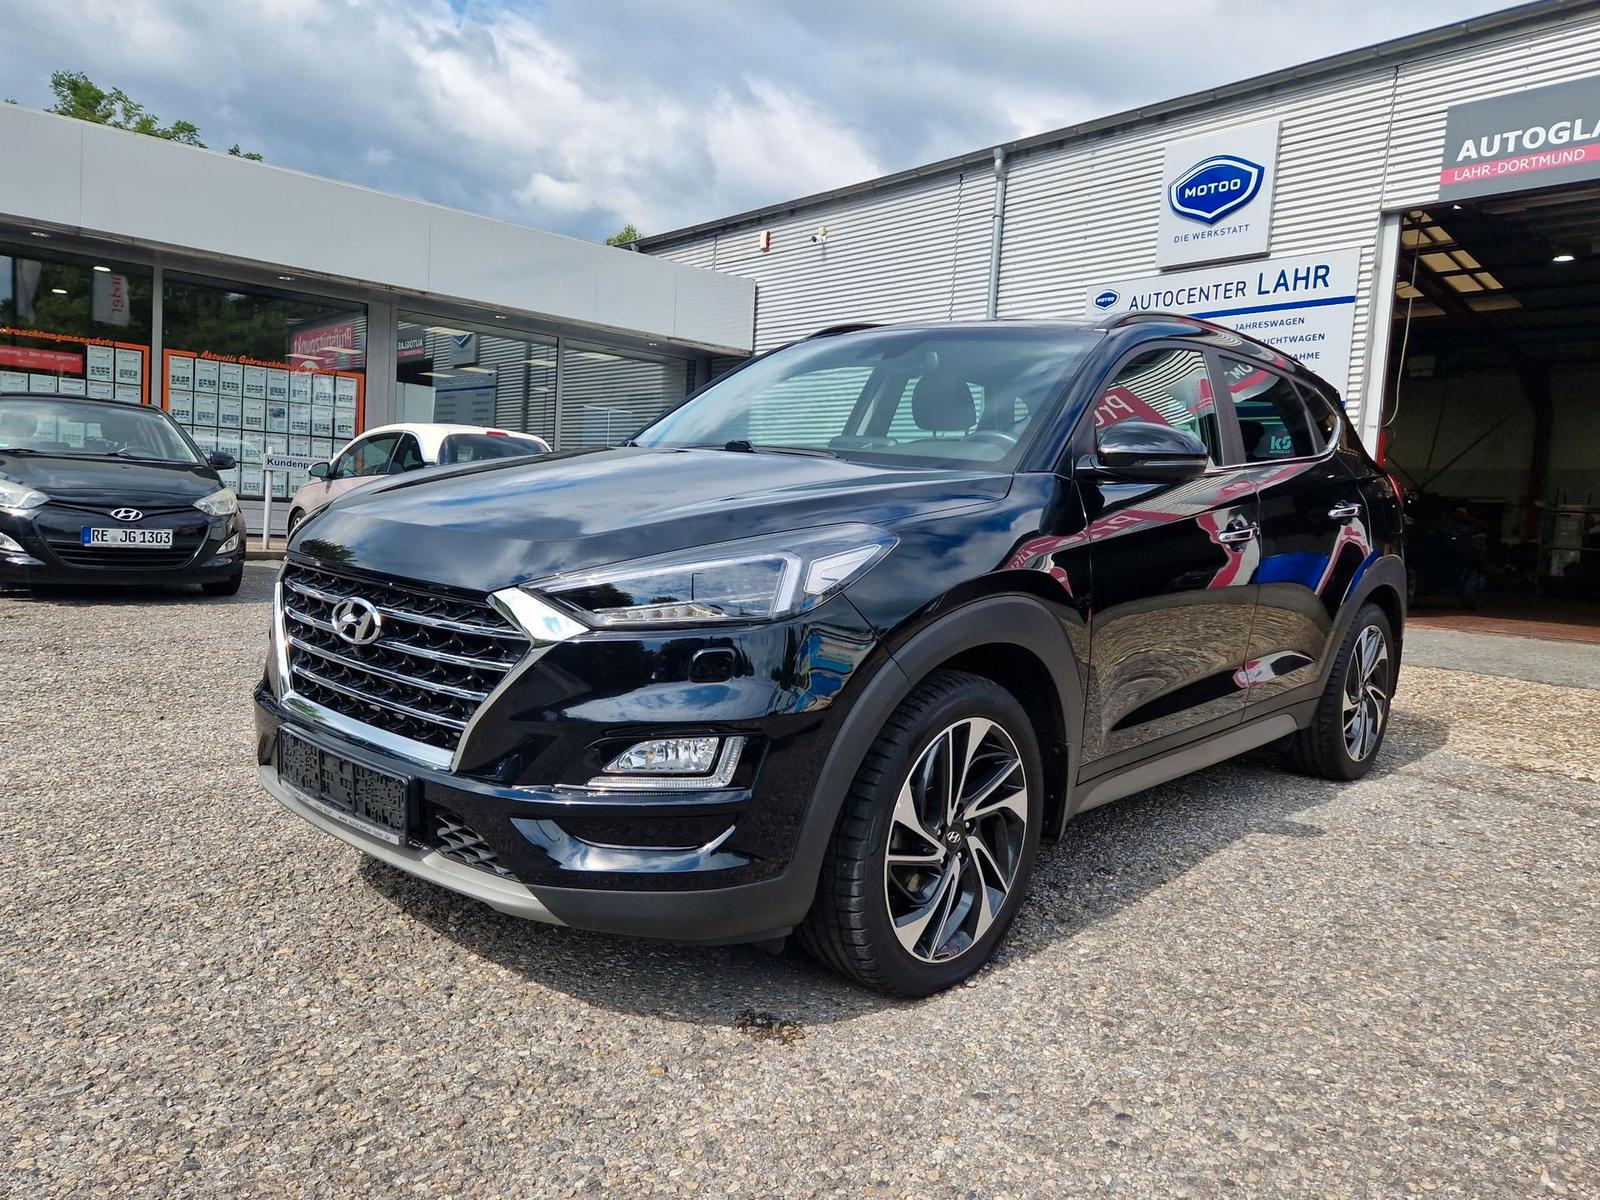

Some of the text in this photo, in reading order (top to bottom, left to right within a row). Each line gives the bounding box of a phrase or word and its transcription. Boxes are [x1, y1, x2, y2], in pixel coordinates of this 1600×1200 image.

[1454, 149, 1585, 181] LAHR-DORTMUND
[1184, 179, 1241, 198] MOTOO
[1174, 224, 1250, 243] DIE WERKSTATT
[1129, 264, 1330, 310] AUTOCENTER LAHR
[1234, 317, 1305, 331] JAHRESWAGEN
[1260, 333, 1325, 346] UCHTWAGEN
[201, 350, 237, 363] Aktuelle
[1291, 351, 1321, 361] AHME
[267, 457, 312, 470] Kundenp
[92, 529, 171, 544] RE JG 1303
